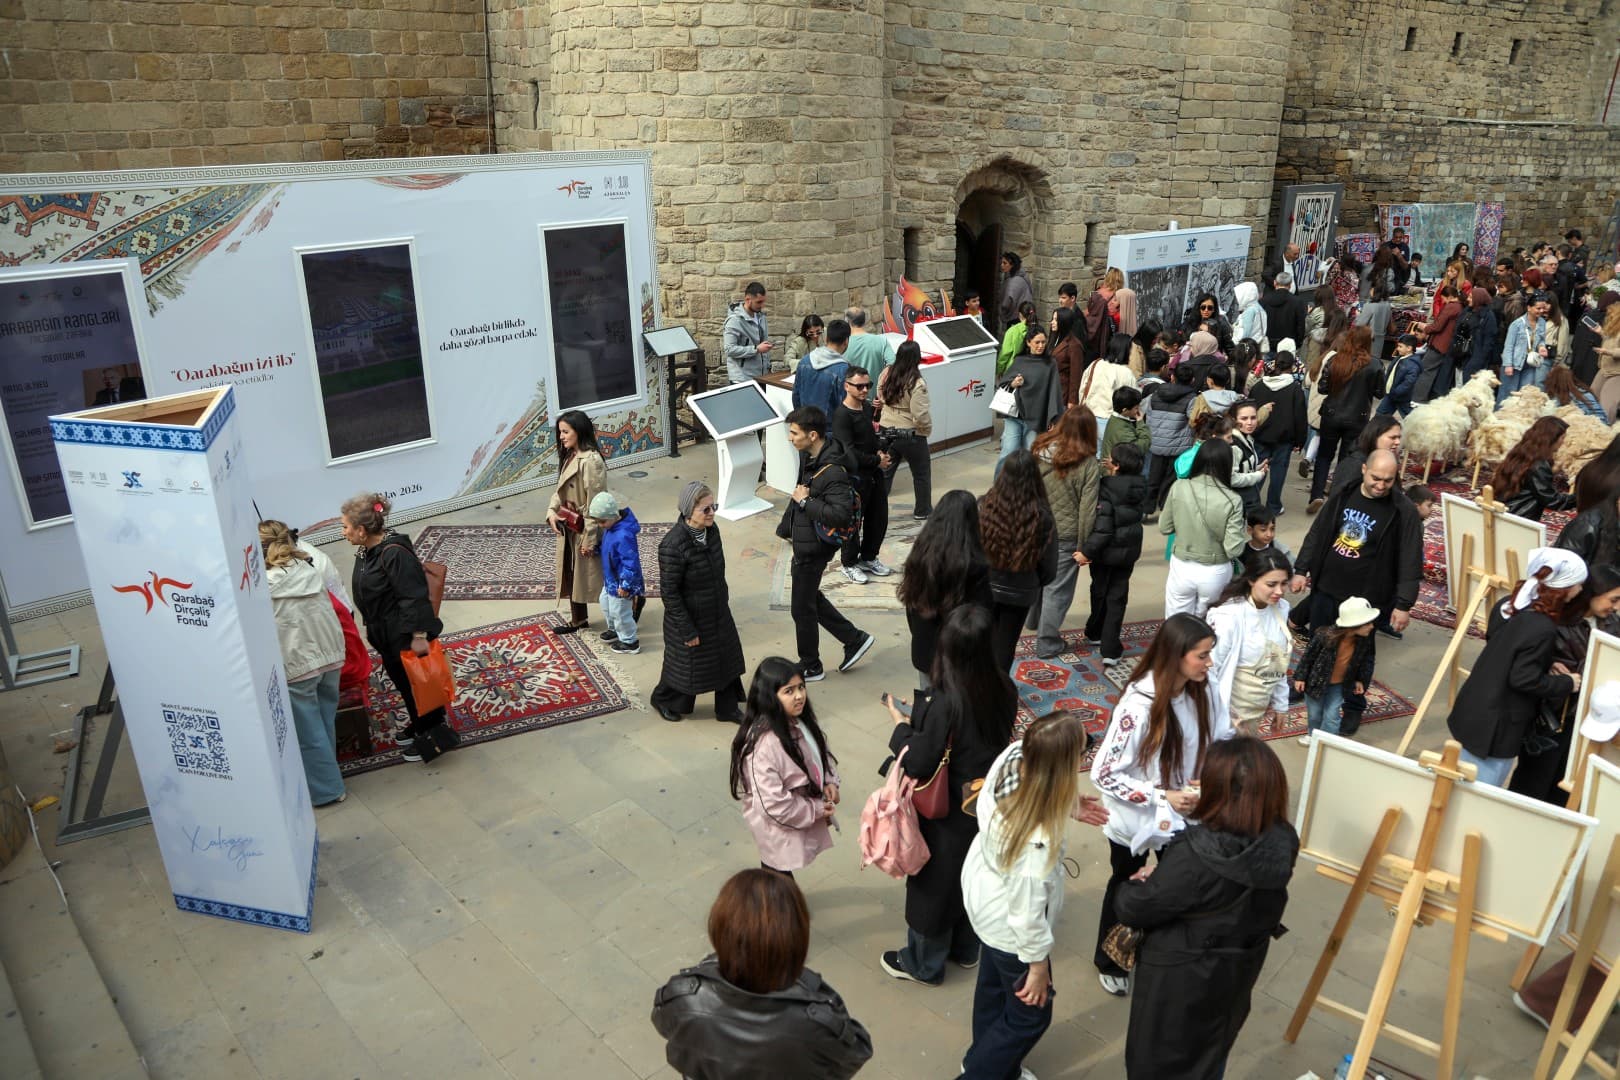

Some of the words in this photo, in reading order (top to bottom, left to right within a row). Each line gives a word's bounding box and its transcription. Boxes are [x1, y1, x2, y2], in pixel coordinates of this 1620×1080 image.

[439, 341, 463, 352] daha
[256, 356, 274, 371] izi
[399, 484, 423, 496] 2026
[1343, 508, 1377, 532] SKULL
[1331, 538, 1361, 559] VIBES
[171, 592, 215, 608] Qarabağ
[174, 603, 211, 619] Dirçəliş
[176, 614, 208, 627] Fondu
